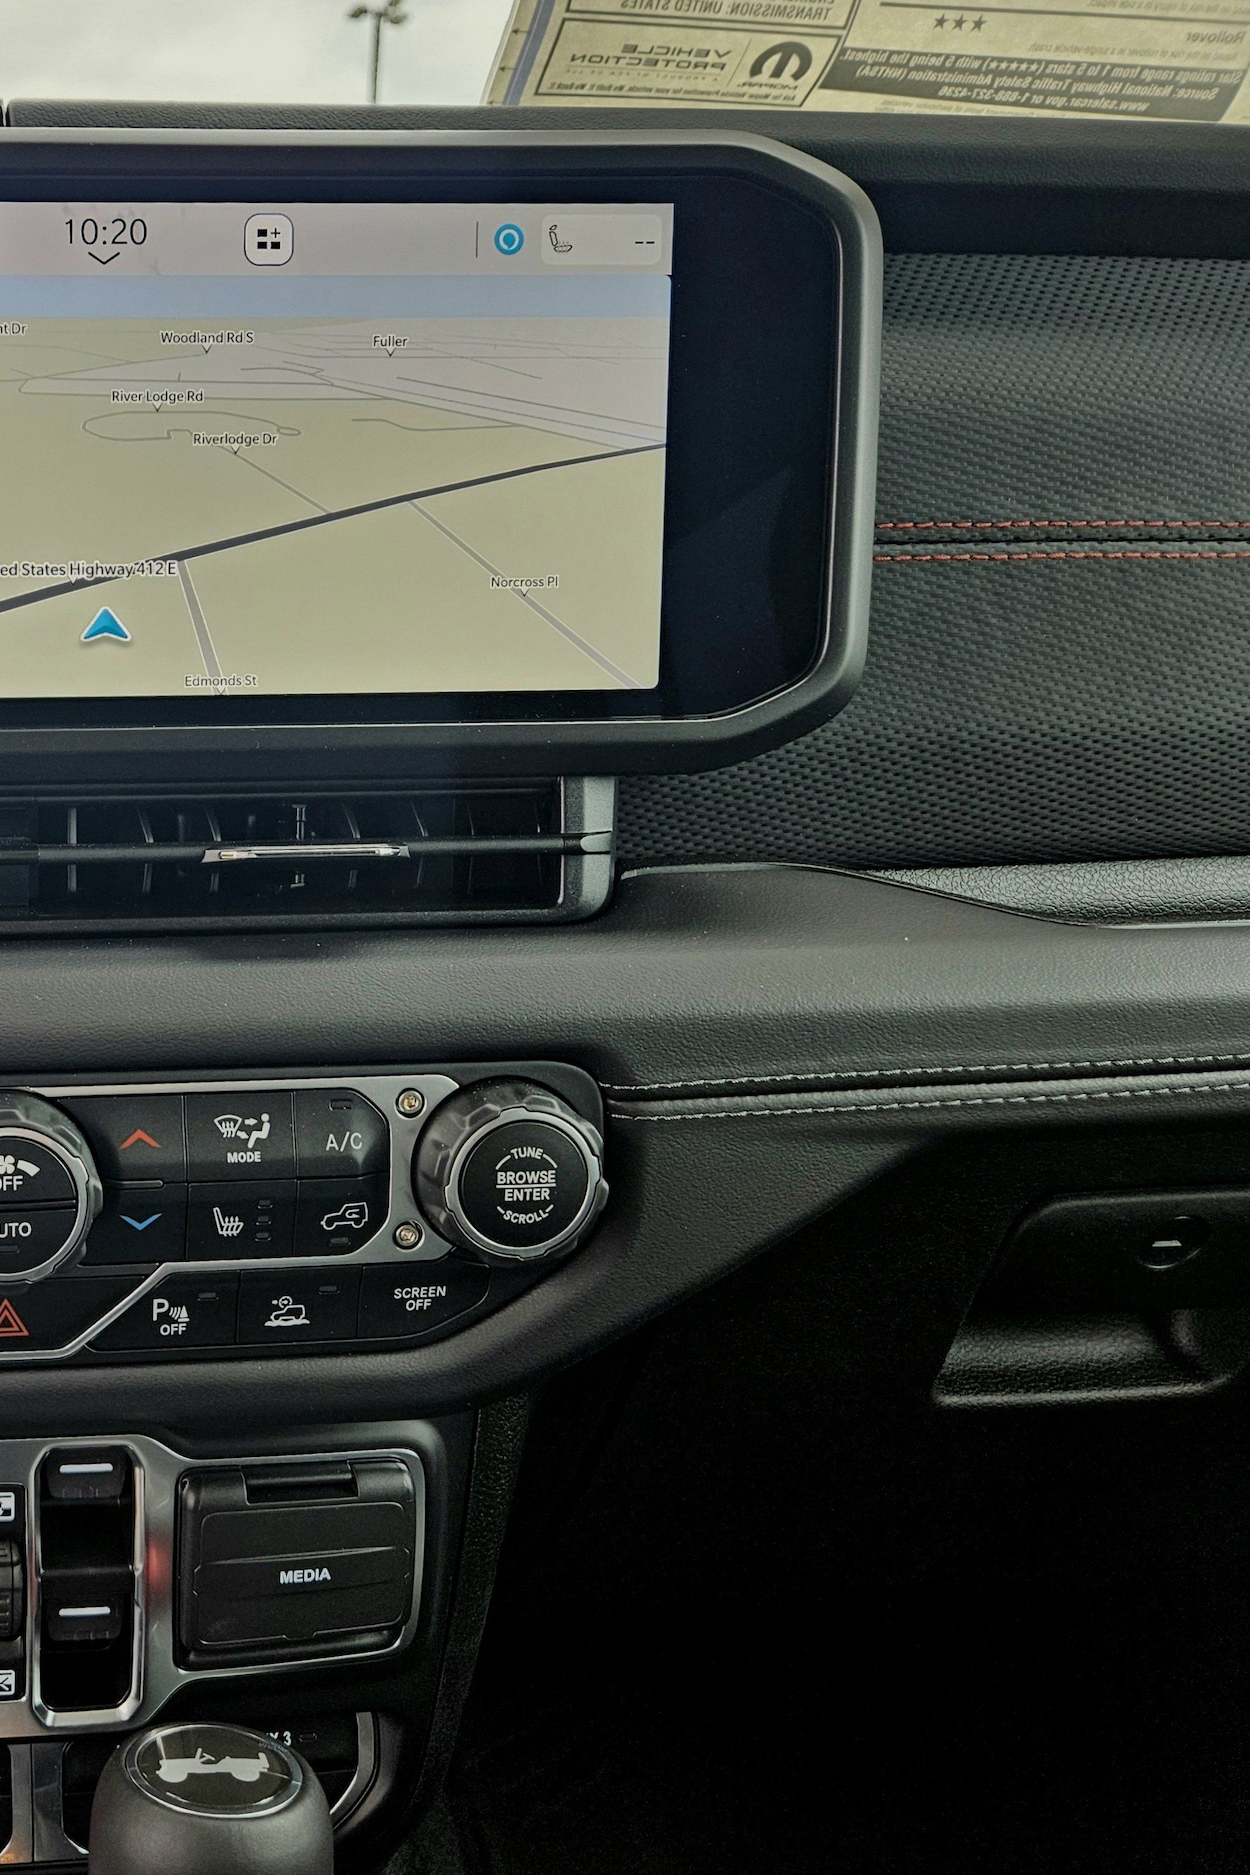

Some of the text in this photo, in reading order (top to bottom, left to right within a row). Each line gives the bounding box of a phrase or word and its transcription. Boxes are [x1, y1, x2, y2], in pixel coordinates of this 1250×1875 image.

[64, 218, 148, 246] 10:20
[10, 322, 27, 335] Dr
[161, 332, 254, 344] Woodland Rd S
[372, 335, 408, 348] Fuller
[111, 391, 203, 405] River Lodge Rd
[193, 433, 278, 447] Riverlodge Dr
[22, 563, 66, 576] States
[69, 562, 133, 579] Highway
[136, 562, 164, 576] 412
[167, 562, 177, 576] E
[490, 575, 559, 588] Norcross Pl
[184, 675, 258, 687] Edmonds St
[326, 1132, 363, 1153] A/C
[227, 1151, 261, 1163] MODE
[510, 1147, 543, 1160] TUNE
[497, 1170, 556, 1184] BROWSE
[504, 1187, 551, 1202] ENTER
[503, 1208, 548, 1225] SCROLL
[394, 1285, 447, 1299] SCREEN
[405, 1299, 432, 1311] OFF
[160, 1323, 187, 1337] OFF
[280, 1567, 331, 1585] MEDIA
[283, 1731, 291, 1746] 3
